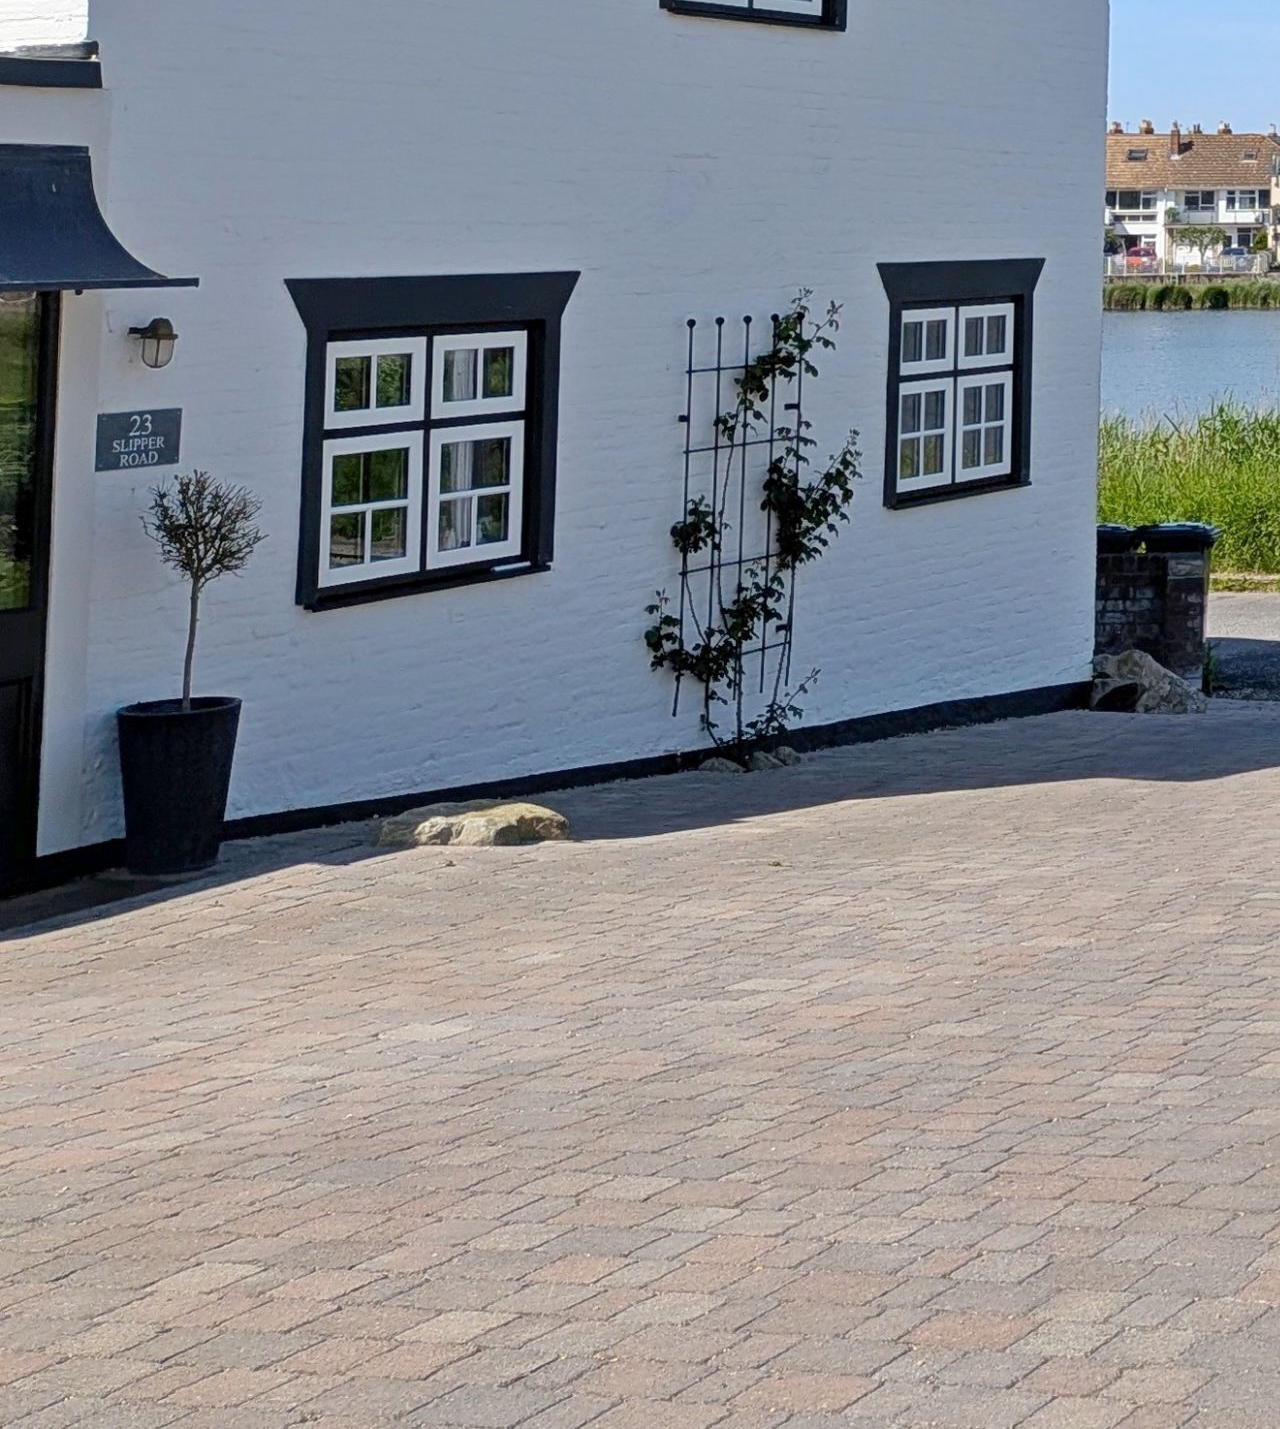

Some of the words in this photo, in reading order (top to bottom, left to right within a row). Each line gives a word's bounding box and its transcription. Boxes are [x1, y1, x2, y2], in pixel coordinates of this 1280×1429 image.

[128, 414, 152, 436] 23
[112, 436, 165, 453] SLIPPER
[119, 451, 159, 467] ROAD
